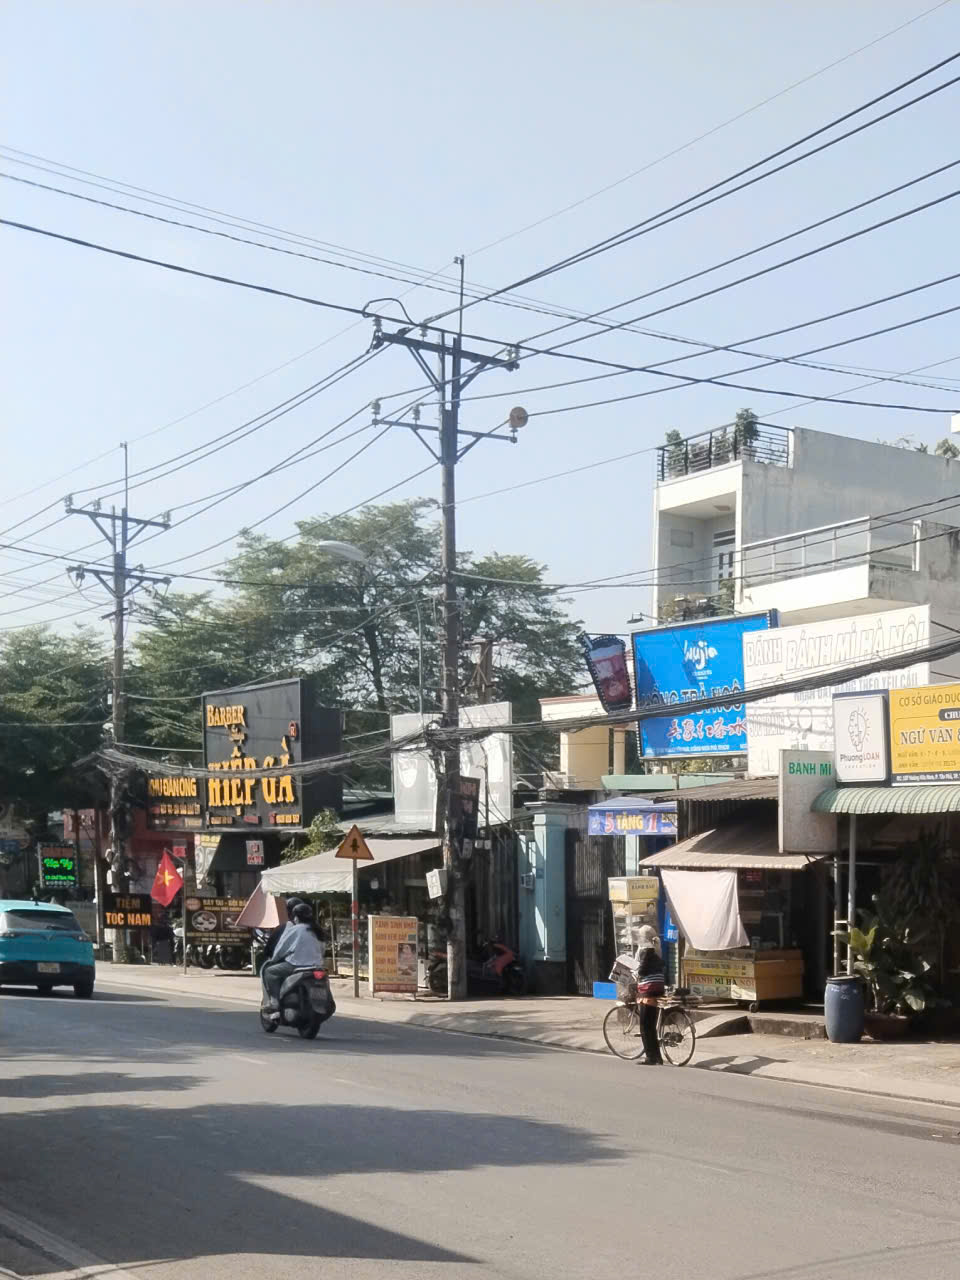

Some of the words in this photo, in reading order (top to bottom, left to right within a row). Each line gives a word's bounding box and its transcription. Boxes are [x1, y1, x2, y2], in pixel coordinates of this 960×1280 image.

[899, 695, 911, 708] CƠ
[911, 691, 922, 706] SỞ
[924, 692, 943, 706] GIÁO
[207, 704, 246, 728] BARBER
[901, 726, 925, 745] NGỮ
[929, 725, 954, 744] VĂN
[208, 746, 257, 816] HIỆP
[262, 736, 295, 804] GÀ
[605, 811, 614, 833] 5
[127, 912, 151, 926] NAM
